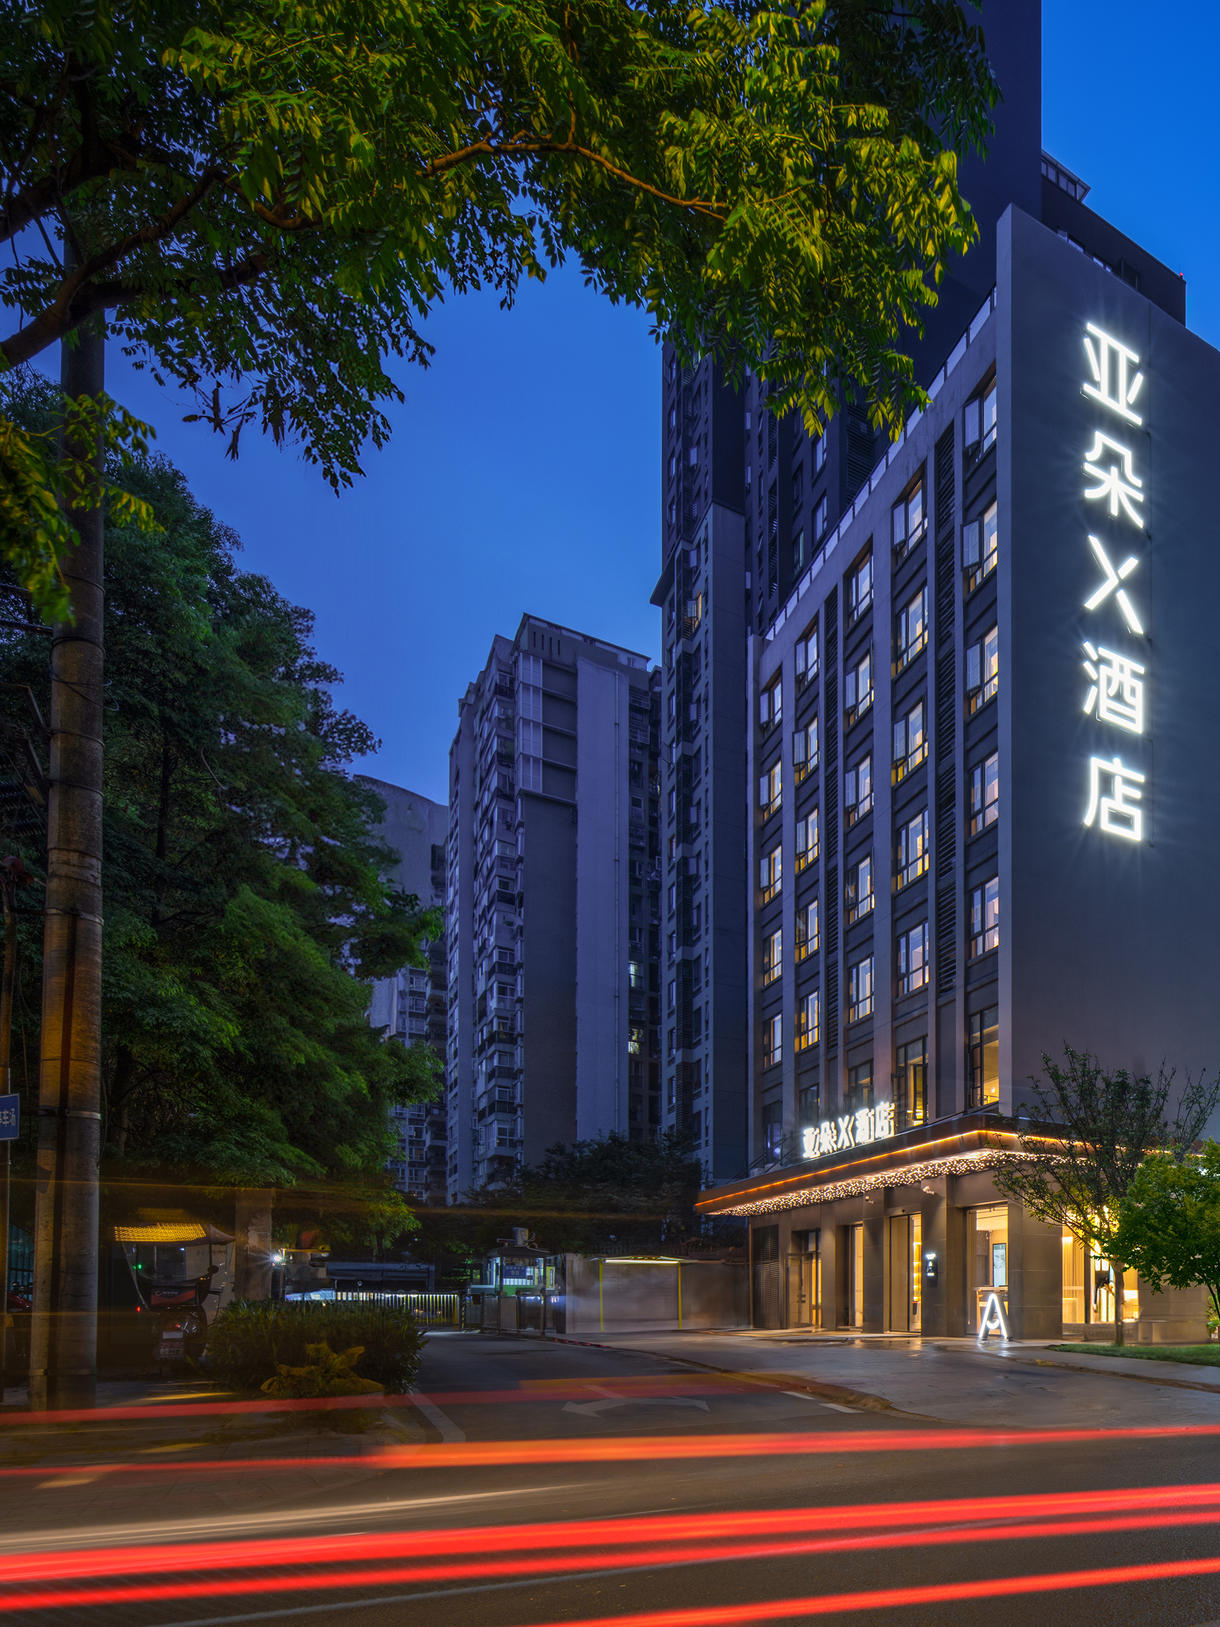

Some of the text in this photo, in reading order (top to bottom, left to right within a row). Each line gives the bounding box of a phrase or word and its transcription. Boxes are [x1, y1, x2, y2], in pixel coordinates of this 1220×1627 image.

[1082, 321, 1146, 842] 亚朵X酒店
[0, 1108, 16, 1127] 车场
[803, 1101, 896, 1158] 亚朵X酒店
